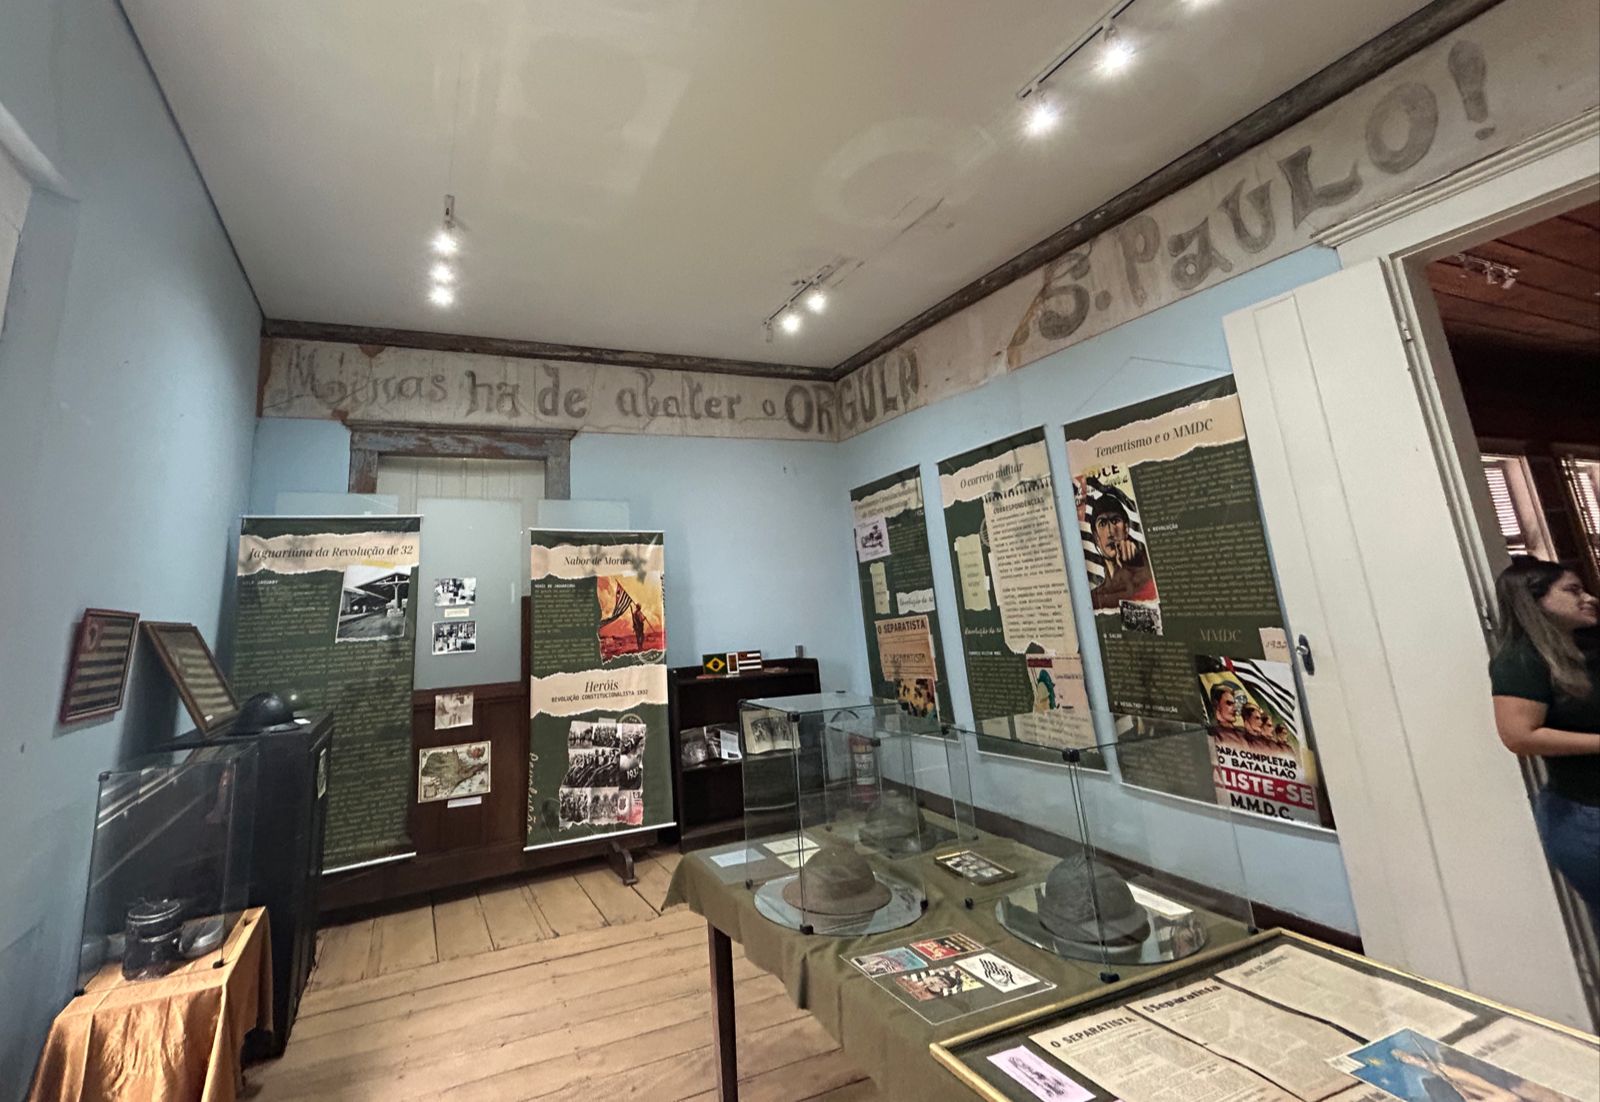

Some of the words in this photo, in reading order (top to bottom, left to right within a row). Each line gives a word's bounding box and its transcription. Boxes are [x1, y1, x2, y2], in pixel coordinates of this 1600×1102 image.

[537, 362, 588, 419] de
[614, 368, 742, 420] abater
[1094, 435, 1152, 459] Tenentismo
[1155, 434, 1160, 443] e
[1163, 432, 1169, 442] o
[1172, 418, 1214, 440] MMDC
[960, 479, 967, 489] O
[967, 471, 994, 488] correio
[315, 547, 330, 558] da
[332, 546, 385, 559] Revolução
[387, 545, 399, 556] de
[400, 545, 413, 555] 32
[564, 556, 590, 566] Nabor
[883, 619, 927, 634] SEPARATISTA
[1199, 628, 1244, 643] MMDC
[584, 679, 619, 693] Heróis
[551, 695, 580, 703] REVOLUÇÃO
[581, 691, 635, 701] CONSTITUCIONALISTA
[1240, 750, 1297, 770] COMPLETAR
[1231, 758, 1297, 780] BATALHÃO
[1049, 1039, 1062, 1049] O
[1062, 1015, 1137, 1045] SEPARATISTA
